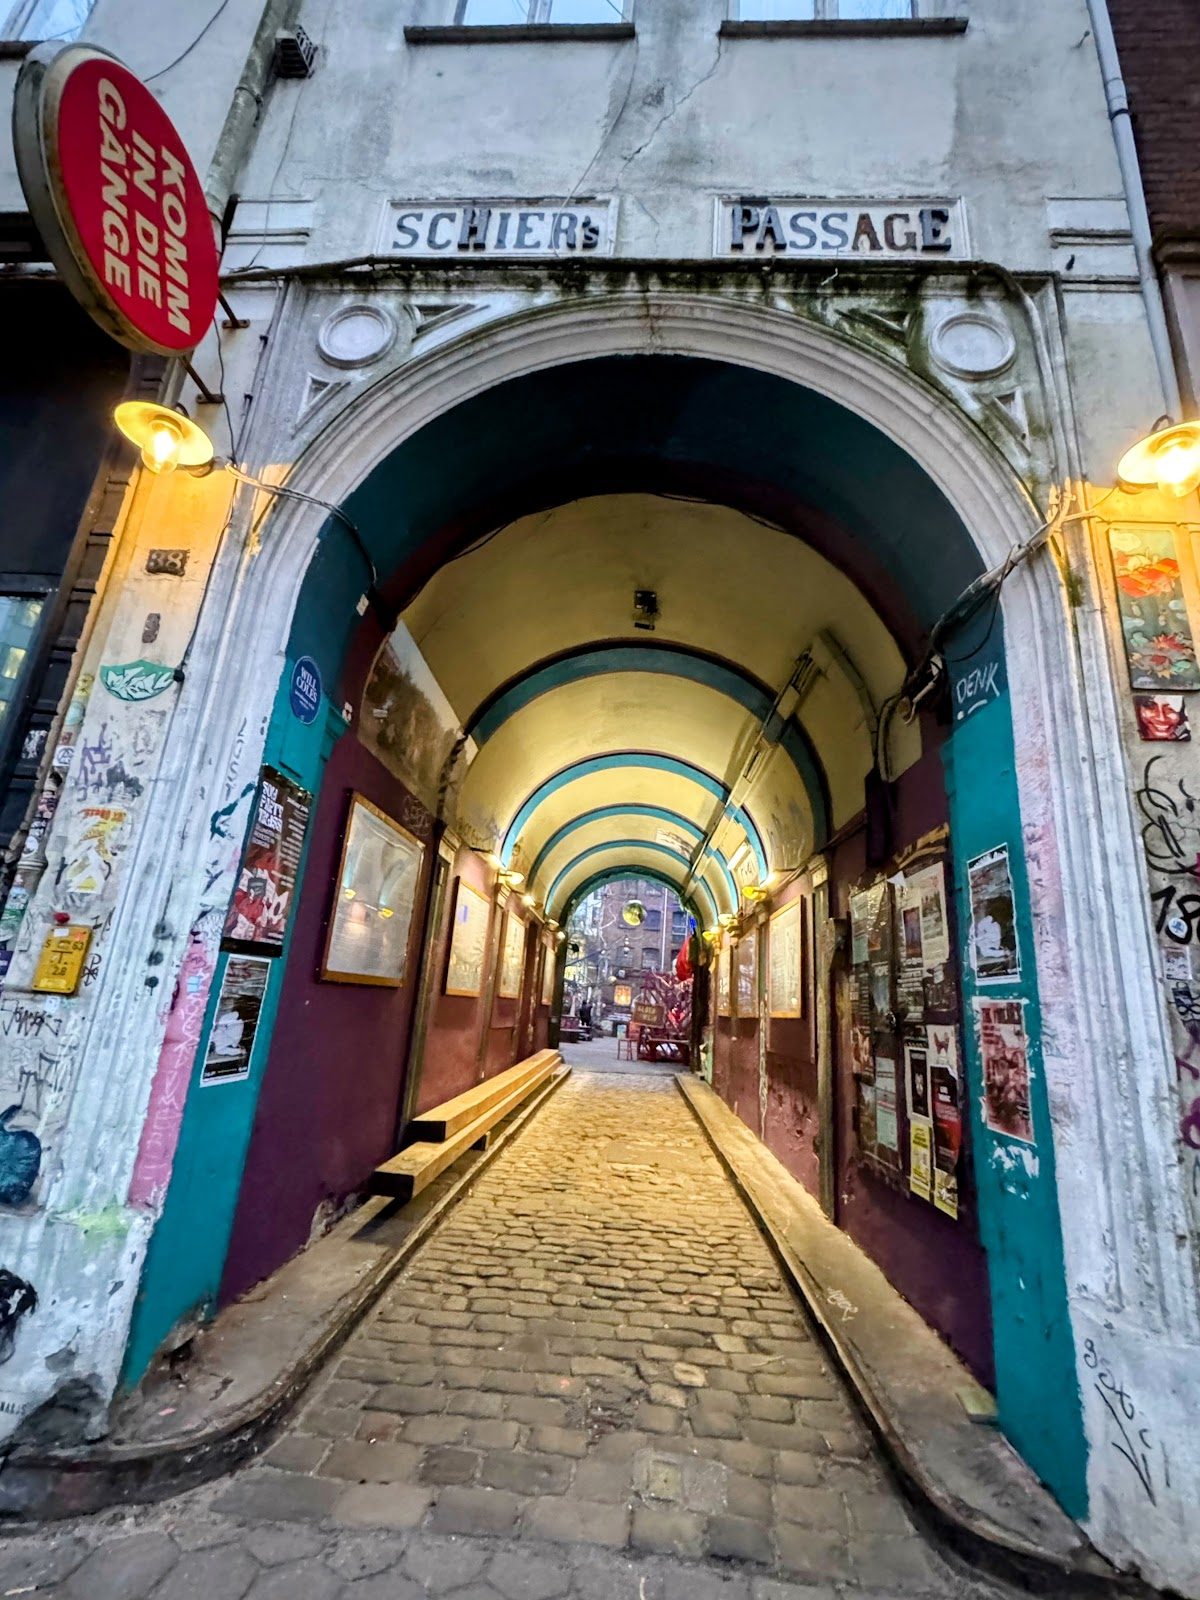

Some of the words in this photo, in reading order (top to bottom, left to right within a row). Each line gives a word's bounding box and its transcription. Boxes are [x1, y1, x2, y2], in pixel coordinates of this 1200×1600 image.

[97, 77, 133, 298] GÄNGE
[131, 129, 157, 202] IN
[161, 145, 192, 336] KOMM
[731, 205, 952, 253] PASSAGE
[135, 209, 163, 309] DIE
[150, 552, 184, 571] 38
[296, 675, 317, 703] COLES
[301, 665, 317, 692] WILL
[956, 662, 1000, 704] DENK
